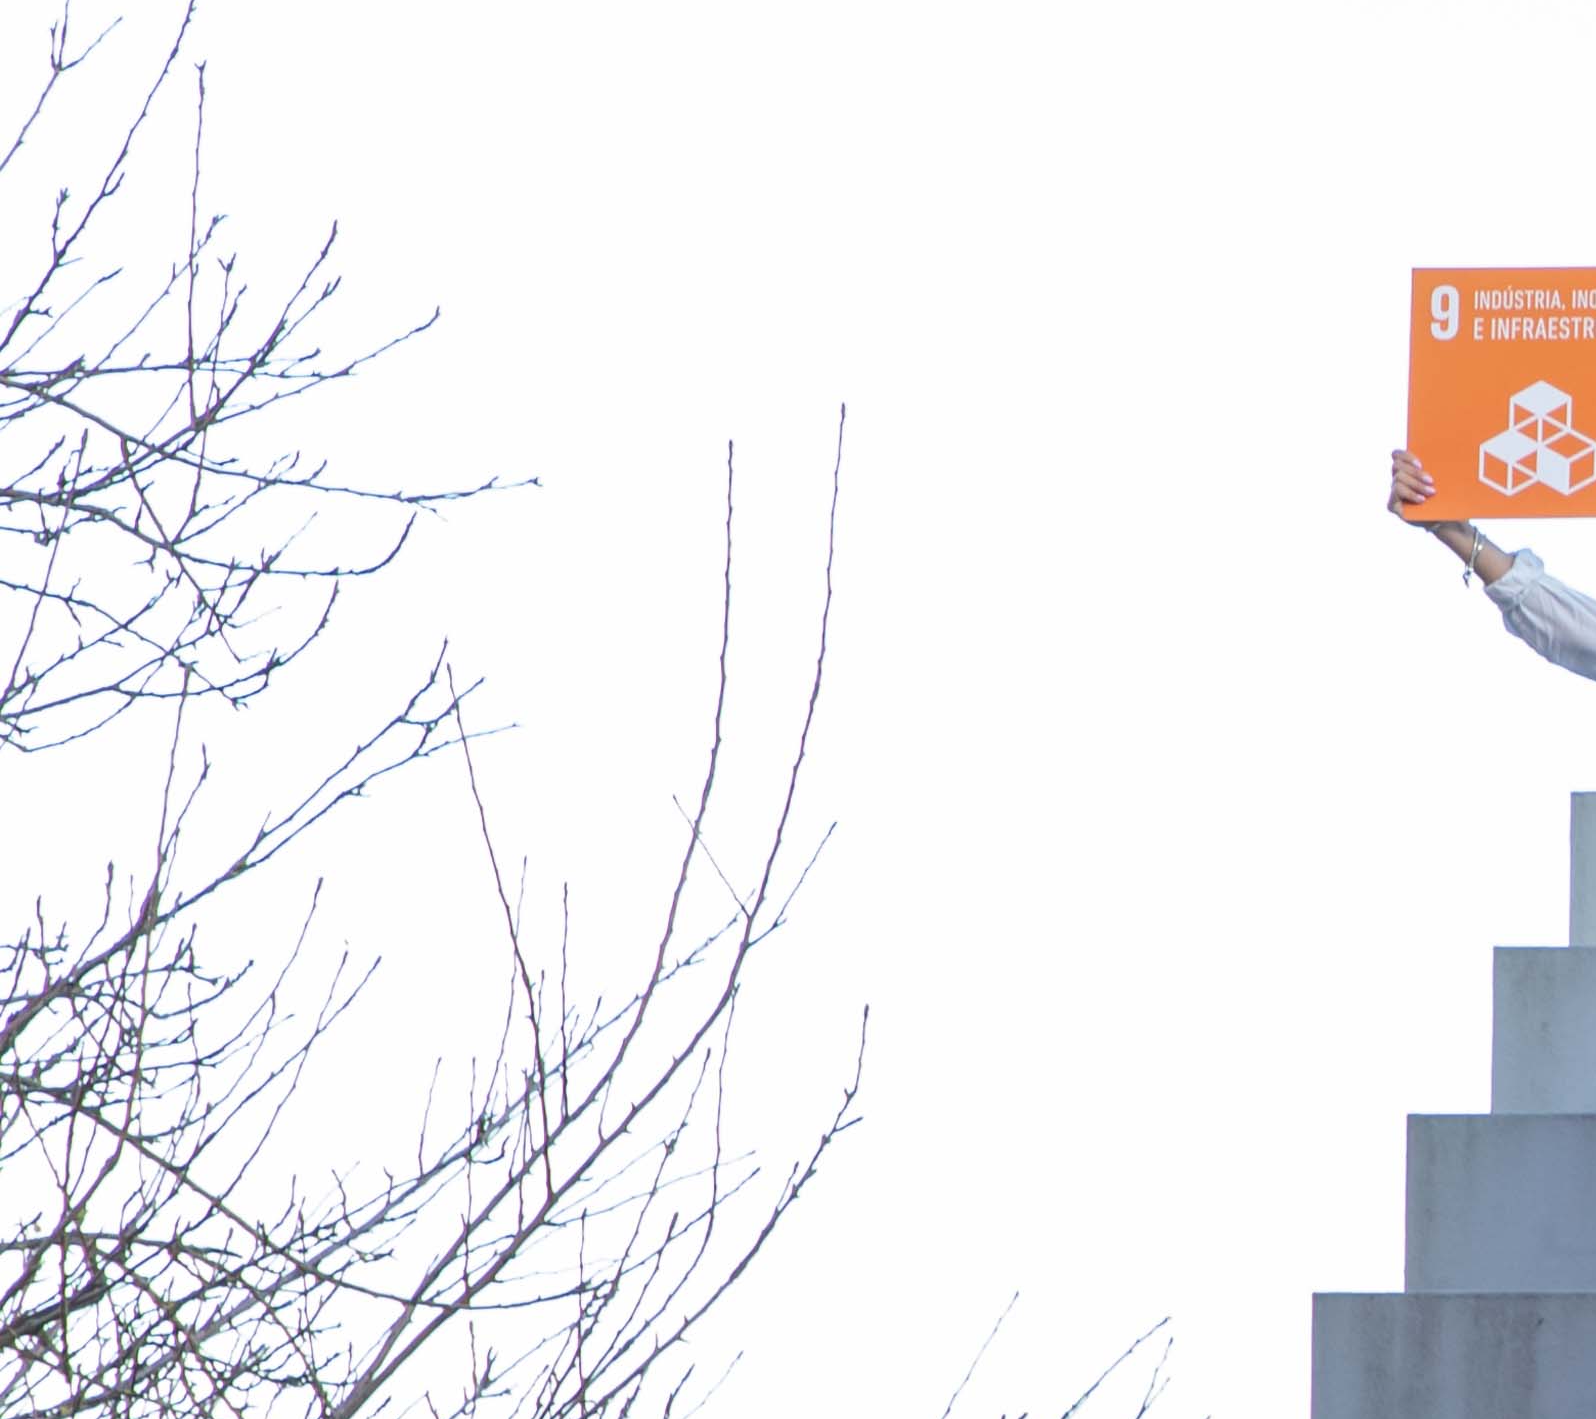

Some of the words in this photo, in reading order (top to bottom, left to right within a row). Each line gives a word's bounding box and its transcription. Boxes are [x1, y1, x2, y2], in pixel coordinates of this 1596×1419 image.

[1474, 285, 1566, 310] INDÚSTRIA,
[1430, 284, 1460, 341] 9
[1473, 317, 1485, 340] E
